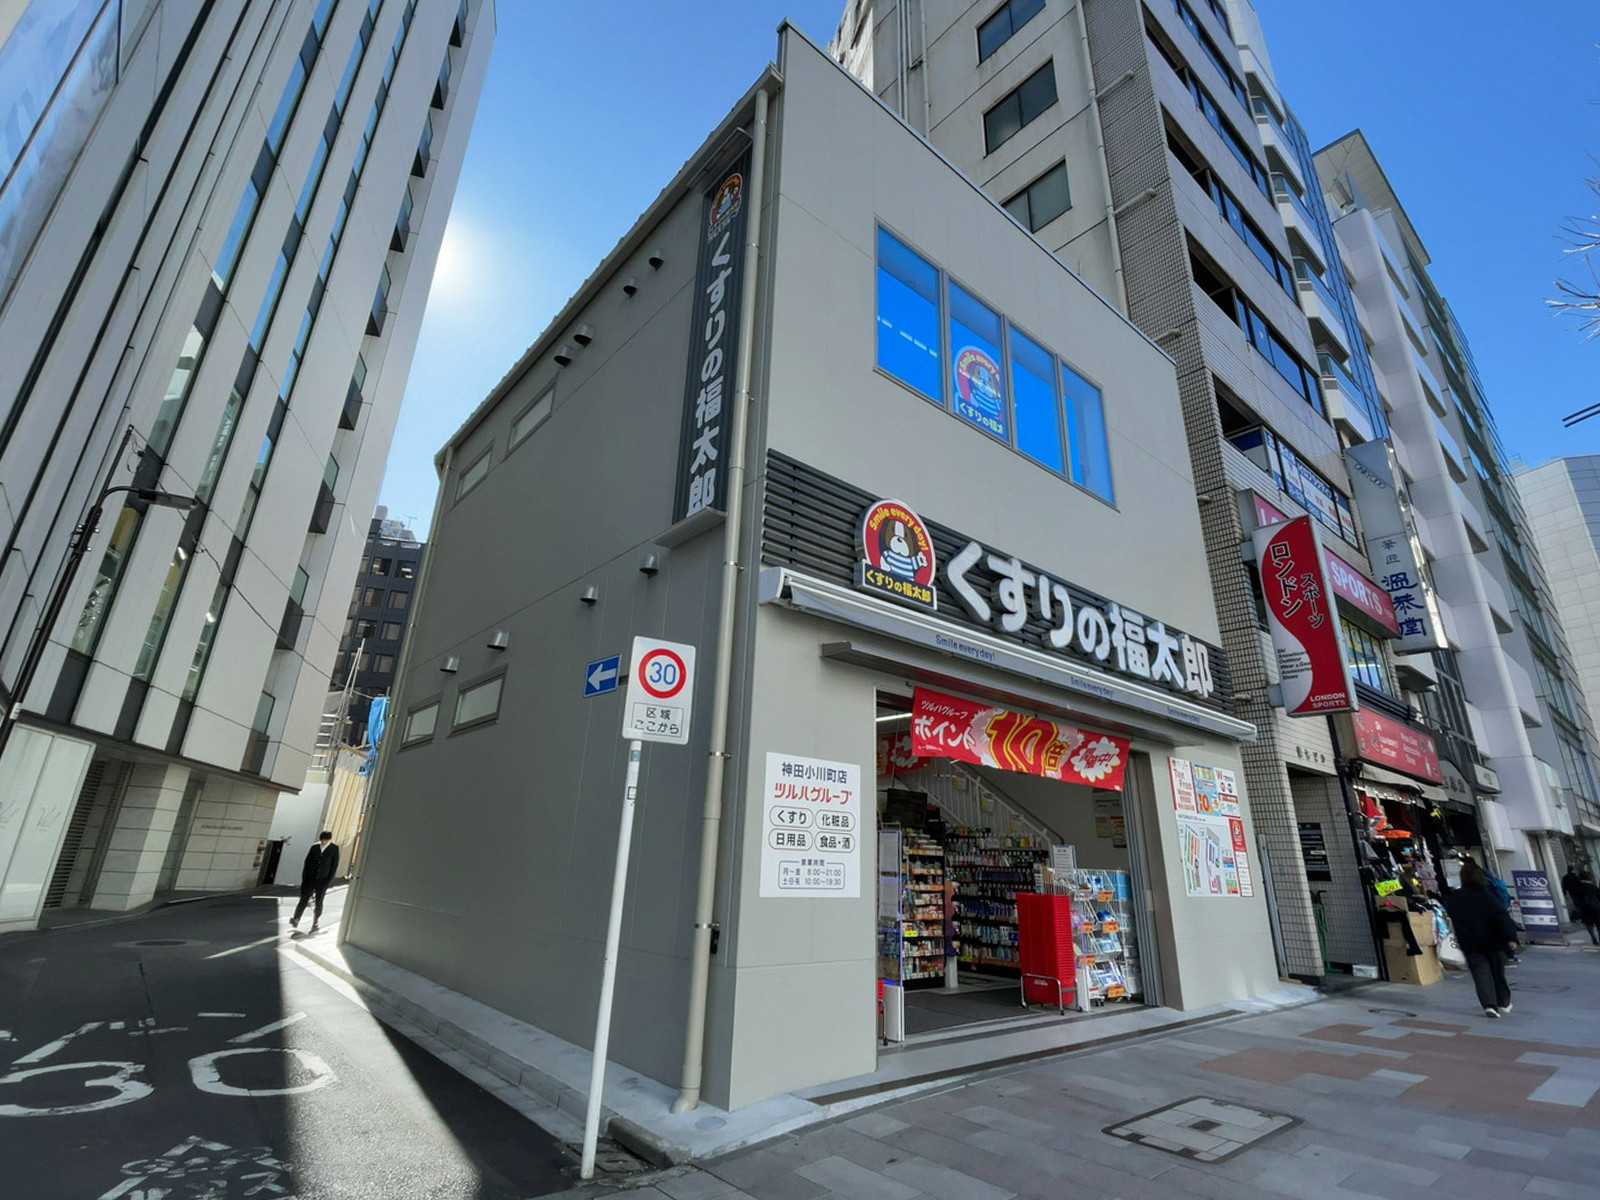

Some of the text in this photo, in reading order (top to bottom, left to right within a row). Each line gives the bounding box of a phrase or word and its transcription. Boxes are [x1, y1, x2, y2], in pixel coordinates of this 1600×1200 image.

[686, 231, 732, 518] くすりの福太郎
[869, 508, 929, 551] Smile every day!
[866, 570, 932, 603] くすりの福太郎
[1271, 541, 1303, 618] ロンドン
[1331, 561, 1384, 616] SPORTS
[1301, 573, 1323, 628] スポーツ
[946, 541, 1215, 698] くすりの福太郎
[935, 634, 957, 650] Smile
[649, 661, 677, 685] 30
[1310, 692, 1345, 702] LONDON
[1312, 700, 1346, 708] SPORTS
[646, 707, 671, 720] 区域
[921, 700, 968, 719] ツルハグループ
[634, 719, 679, 734] ここから
[914, 715, 975, 749] ポイント
[782, 762, 847, 784] 神田小川町店
[774, 783, 852, 805] ツルハグループ
[777, 810, 807, 824] くすり
[822, 814, 849, 828] 化粧品
[776, 833, 806, 847] 日用品
[820, 835, 851, 849] 食品・酒
[1516, 877, 1548, 887] FUSO
[0, 1047, 338, 1117] 30
